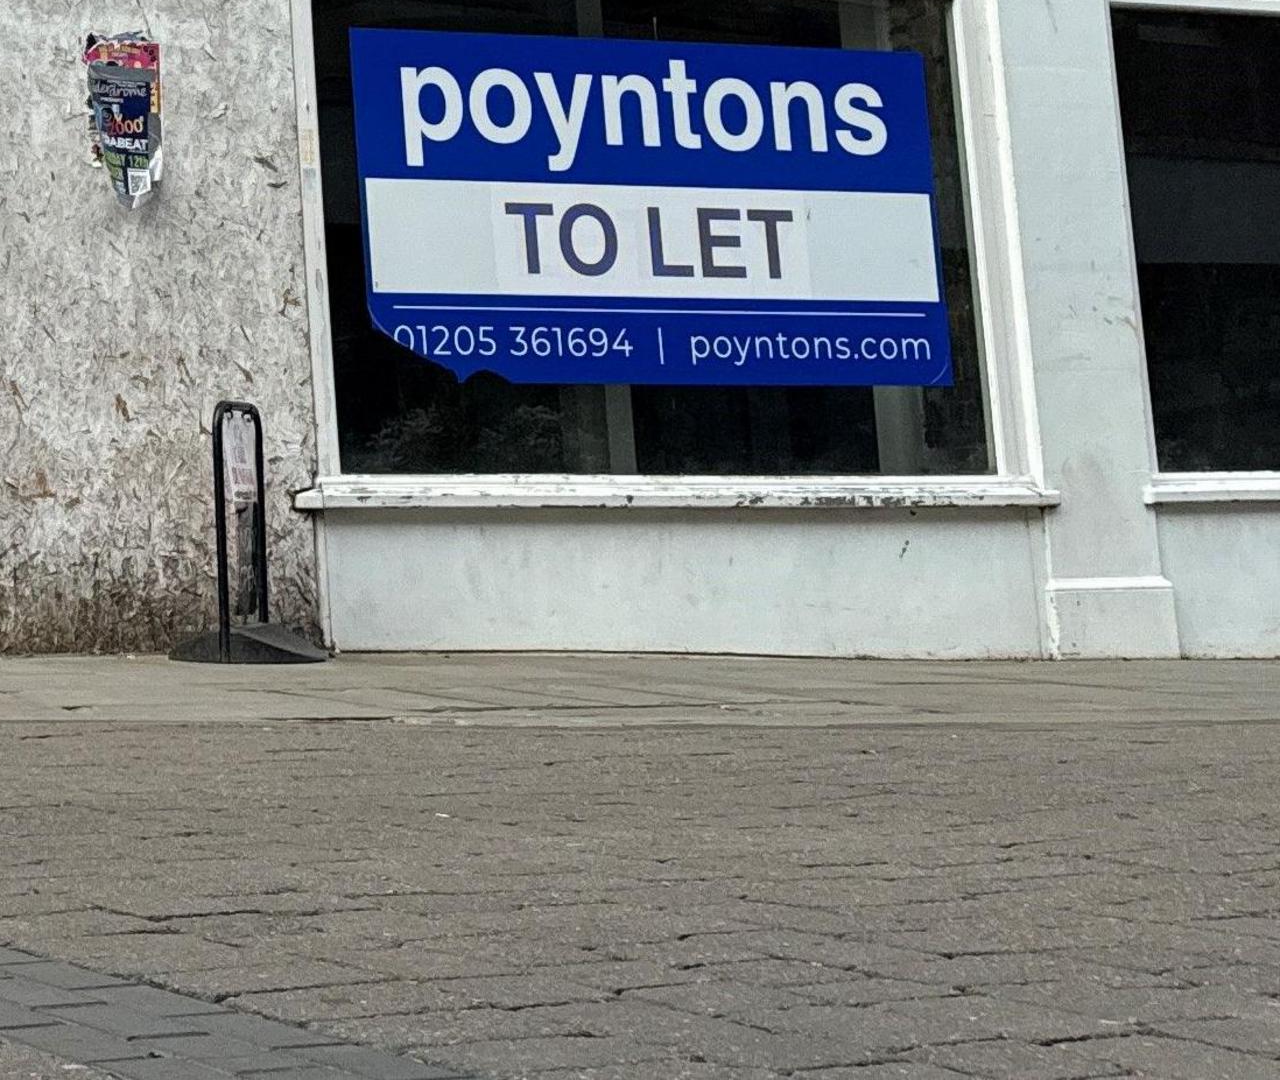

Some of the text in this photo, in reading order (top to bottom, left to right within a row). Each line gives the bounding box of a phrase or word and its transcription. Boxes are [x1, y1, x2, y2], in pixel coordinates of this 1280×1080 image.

[400, 59, 888, 172] poyntons
[505, 202, 793, 280] TO LET
[394, 325, 931, 366] 01205 361694 poyntons.com
